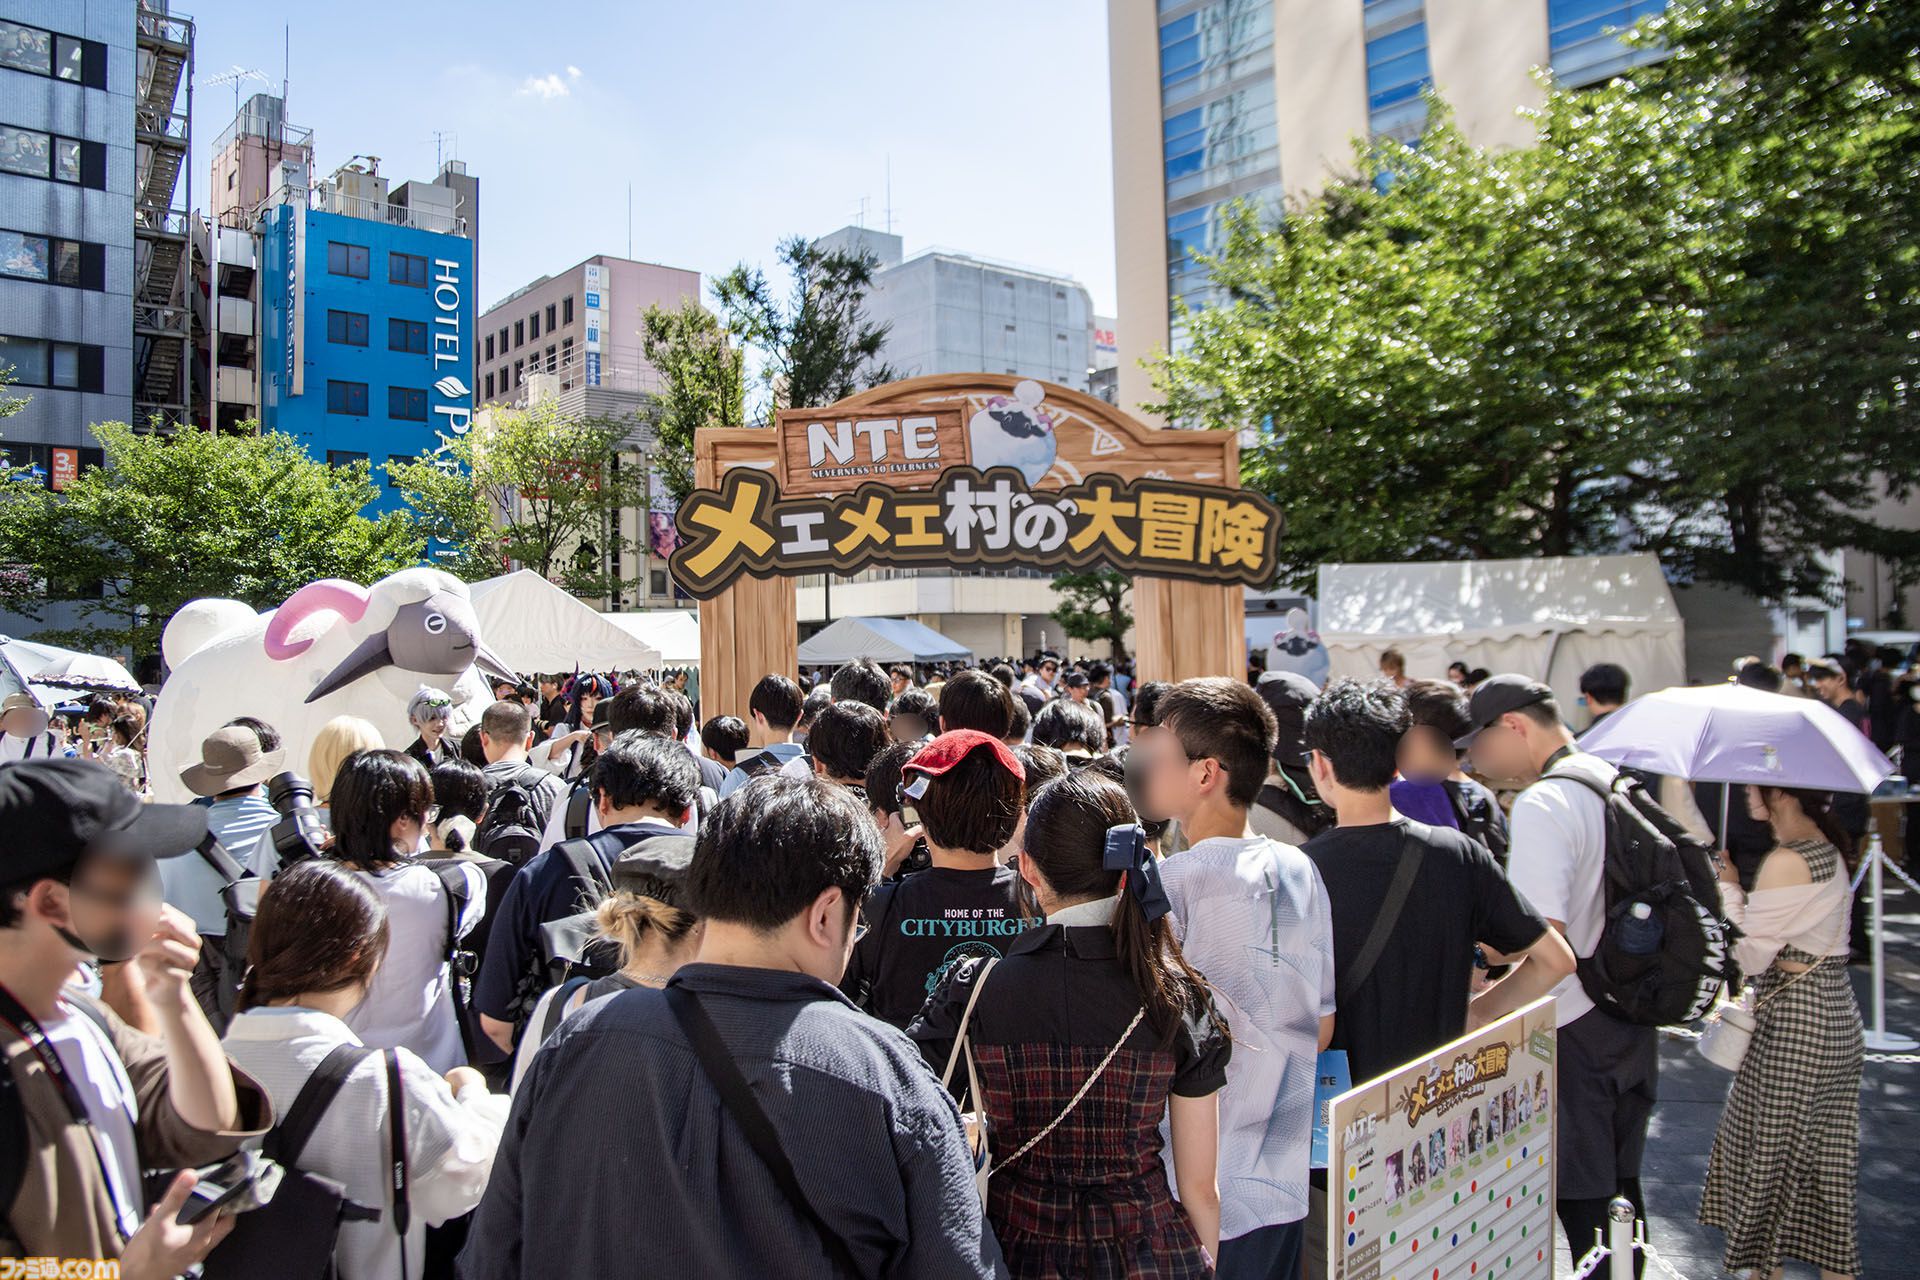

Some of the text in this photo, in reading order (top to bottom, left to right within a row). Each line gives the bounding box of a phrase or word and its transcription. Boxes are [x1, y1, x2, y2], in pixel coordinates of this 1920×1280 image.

[287, 284, 296, 377] PARKSIDE
[434, 258, 460, 371] HOTEL
[55, 452, 76, 474] 3F
[807, 416, 941, 468] NTE
[810, 461, 941, 479] NEVERNESS TO EVERNESS
[684, 479, 1270, 578] メェメェ村の大冒険
[944, 908, 1005, 919] HOME OF THE
[1681, 904, 1728, 1021] NEW ERA
[1345, 1111, 1377, 1142] NTE
